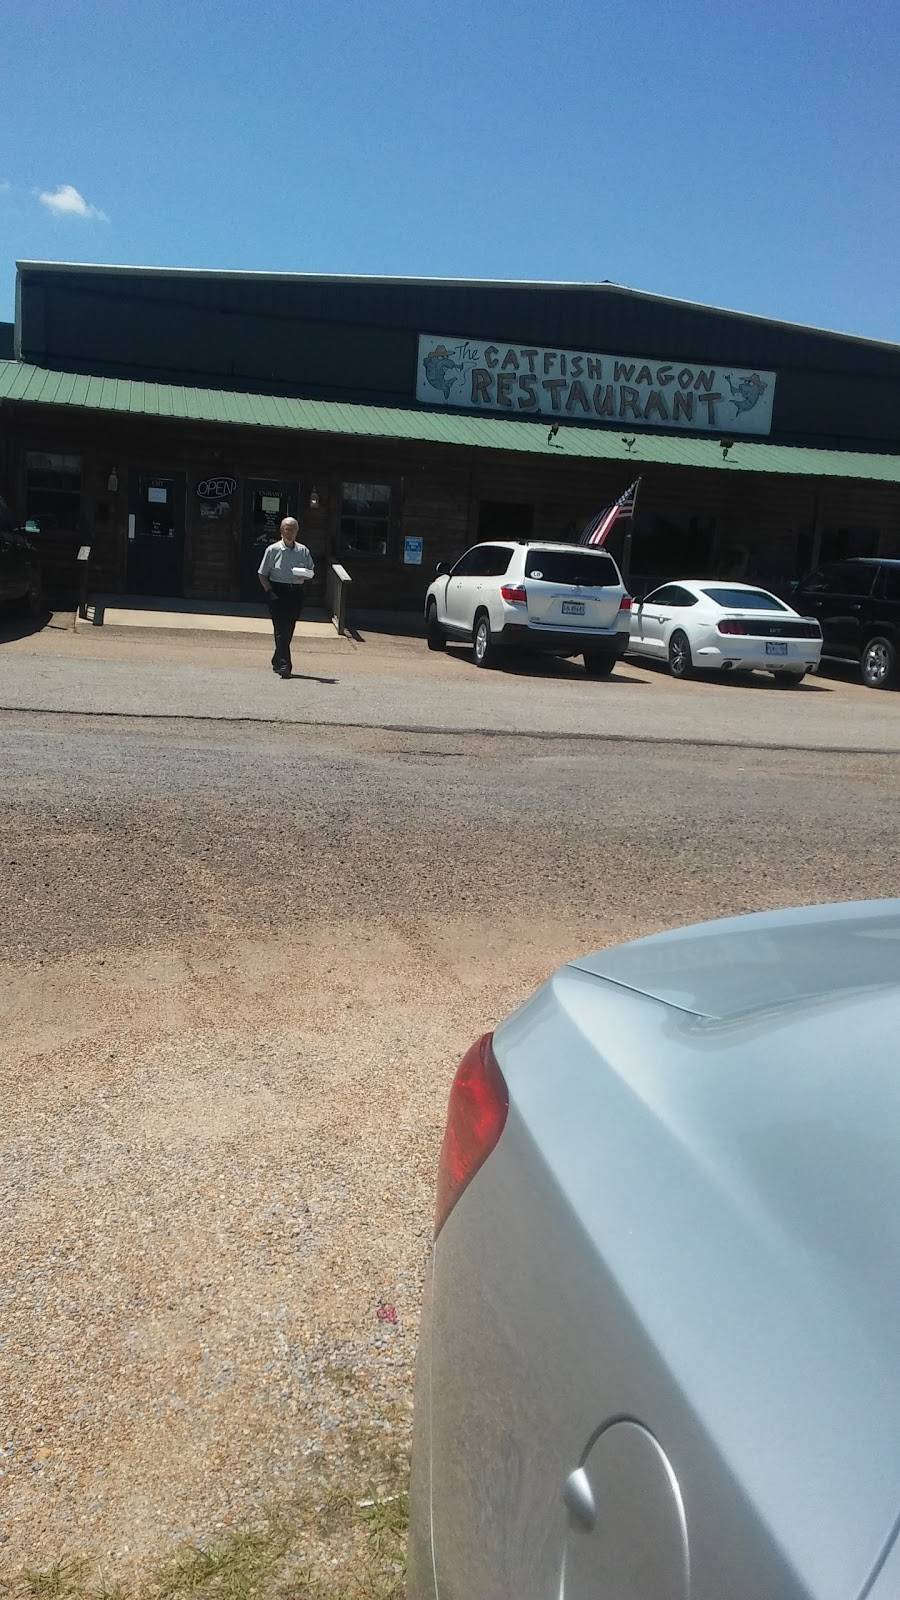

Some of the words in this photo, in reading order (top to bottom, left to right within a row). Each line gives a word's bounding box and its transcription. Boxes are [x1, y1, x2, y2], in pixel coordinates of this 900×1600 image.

[455, 342, 480, 360] The
[484, 345, 602, 379] CATFISH
[613, 362, 715, 392] WAGON
[470, 368, 722, 425] RESTAURANT
[197, 480, 233, 496] OPEN
